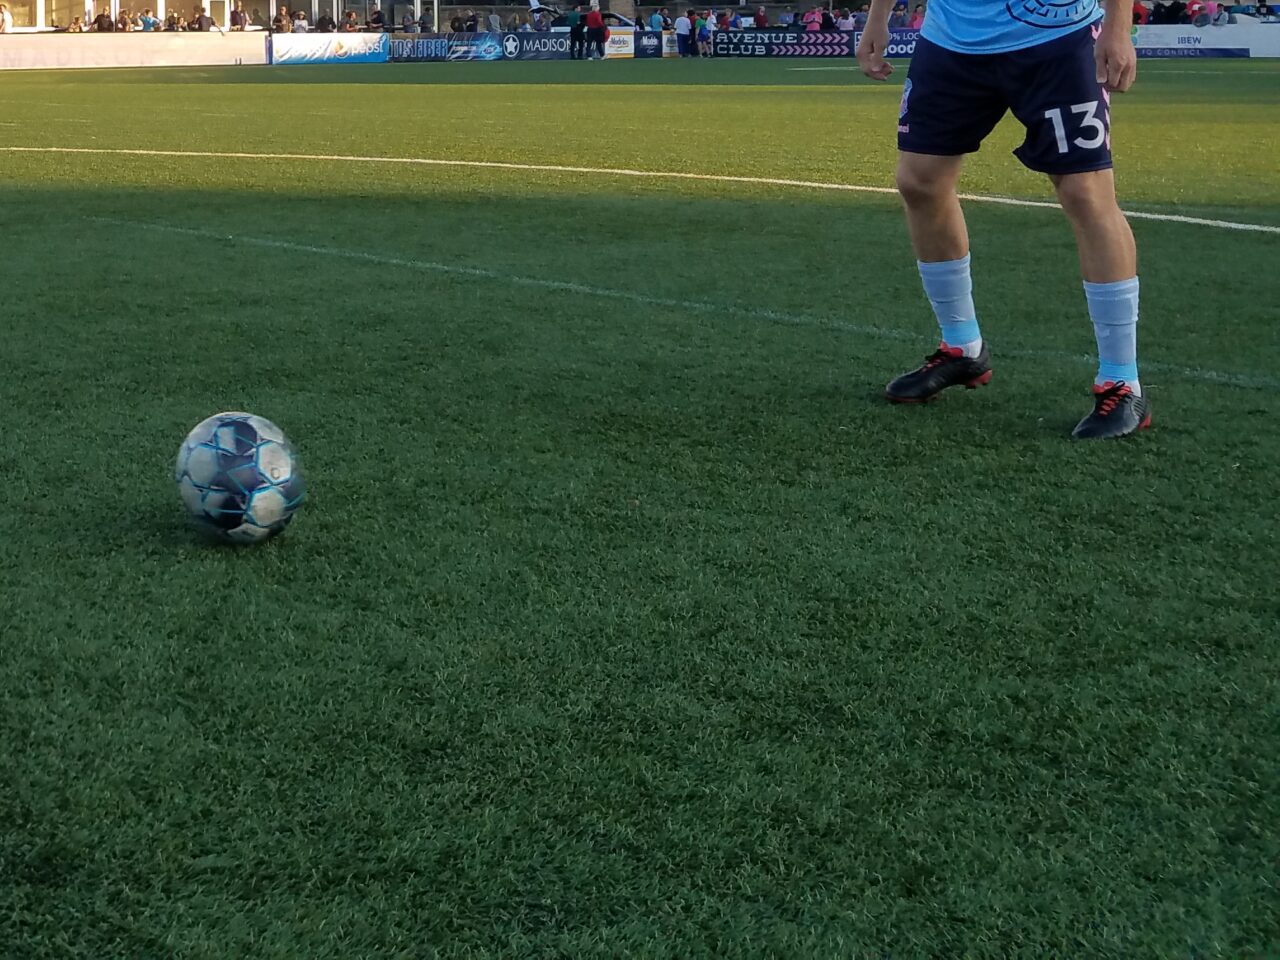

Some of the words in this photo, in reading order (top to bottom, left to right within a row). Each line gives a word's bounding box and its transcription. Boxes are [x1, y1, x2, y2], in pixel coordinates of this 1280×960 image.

[716, 32, 798, 44] AVENUE
[903, 32, 920, 41] LOC
[1177, 36, 1202, 45] IBEW
[351, 38, 384, 56] pepsi
[416, 38, 448, 58] FIBER
[523, 38, 572, 52] MADISON
[716, 43, 767, 56] CLUB
[1044, 100, 1106, 154] 13
